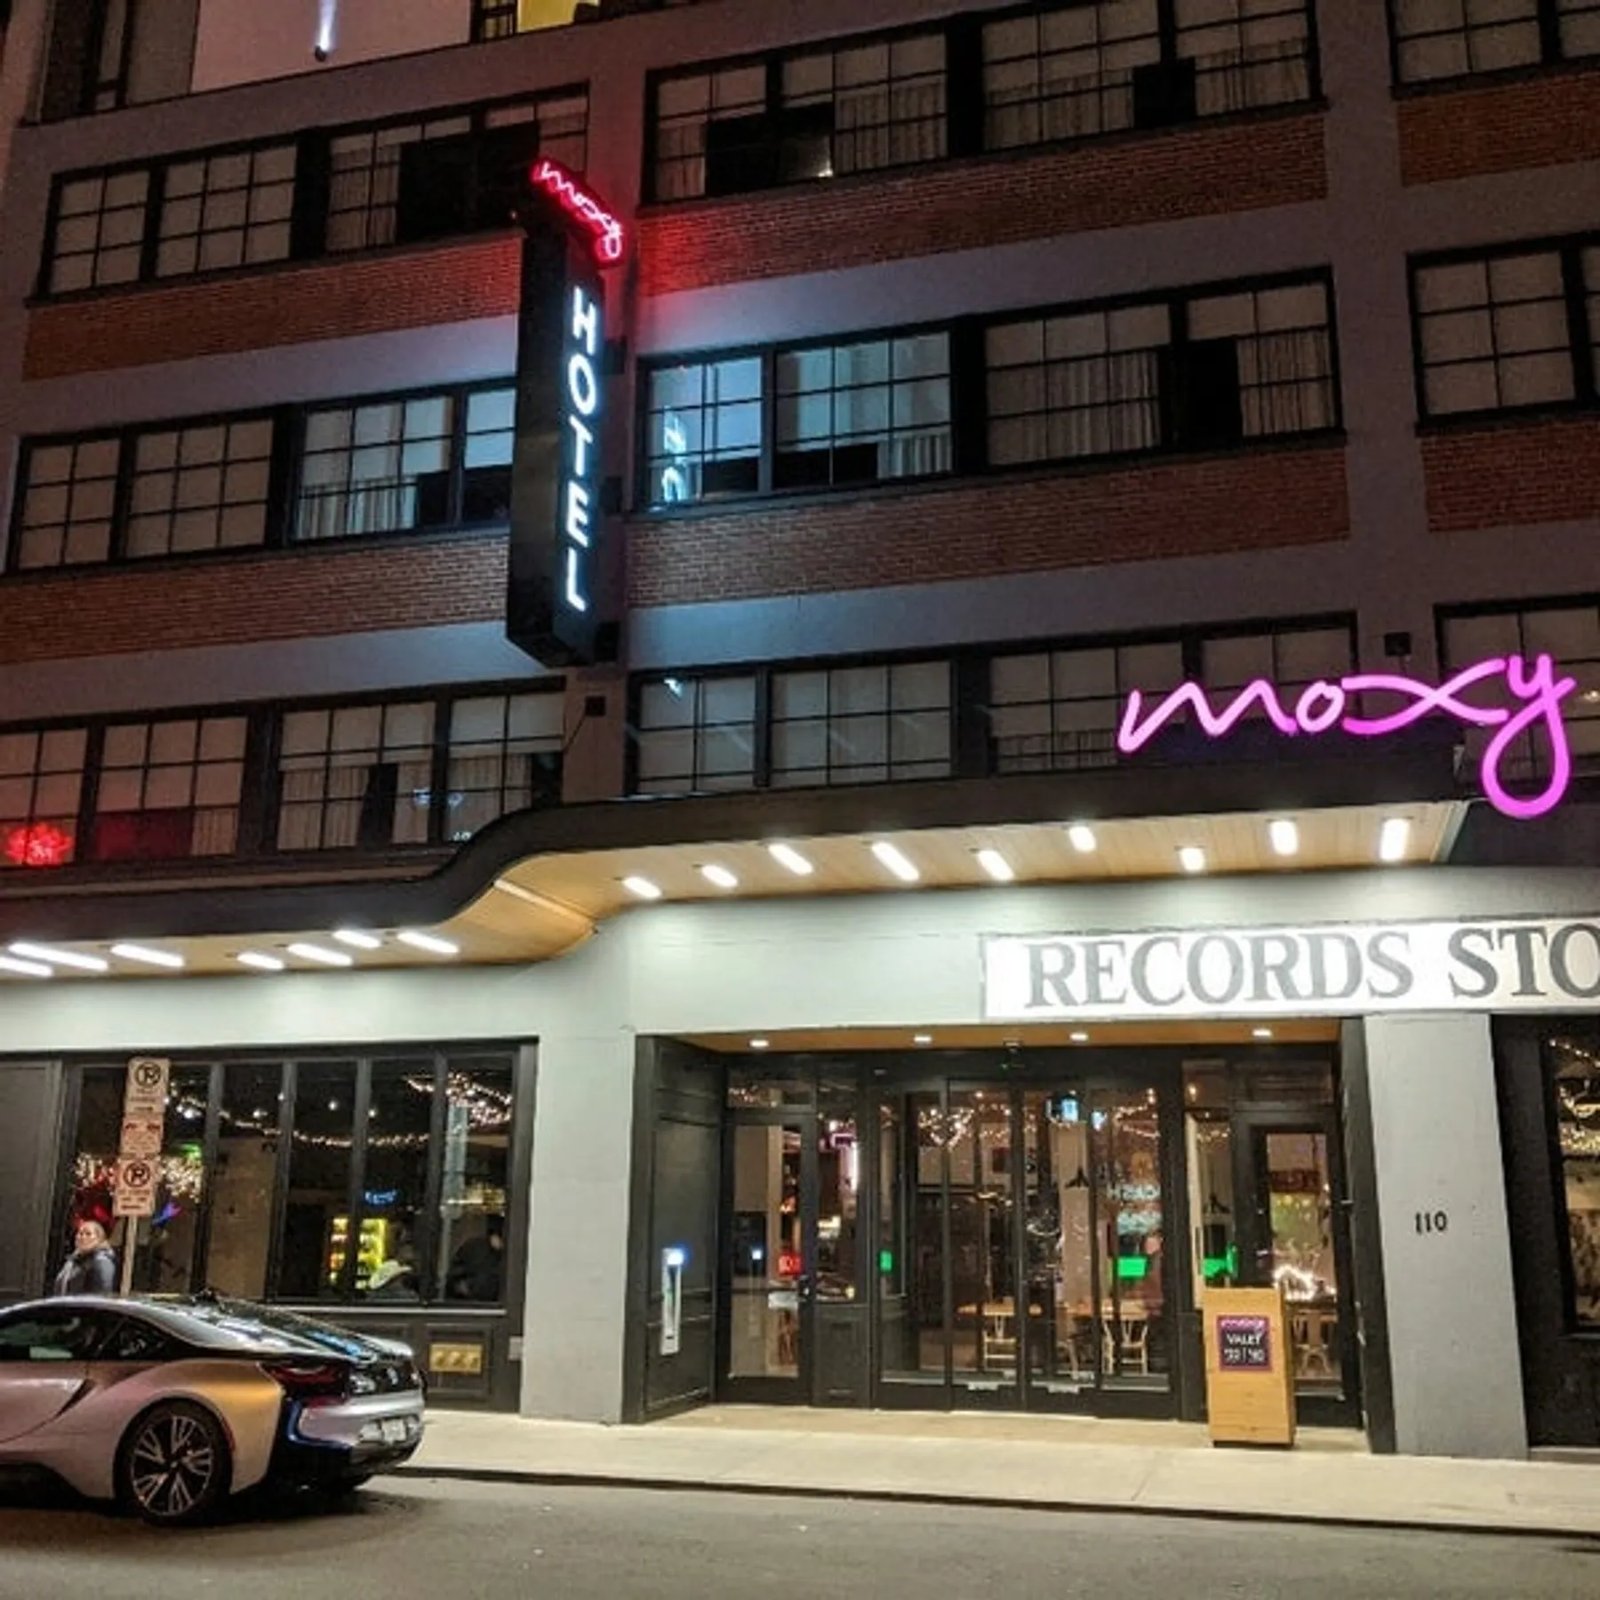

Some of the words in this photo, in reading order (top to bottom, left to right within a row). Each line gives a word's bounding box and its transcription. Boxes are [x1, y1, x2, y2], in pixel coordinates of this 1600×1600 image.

[565, 285, 598, 612] HOTEL
[1116, 653, 1576, 818] moxy
[1023, 930, 1415, 1009] RECORDS
[1447, 923, 1600, 999] STO
[1415, 1210, 1448, 1235] 110
